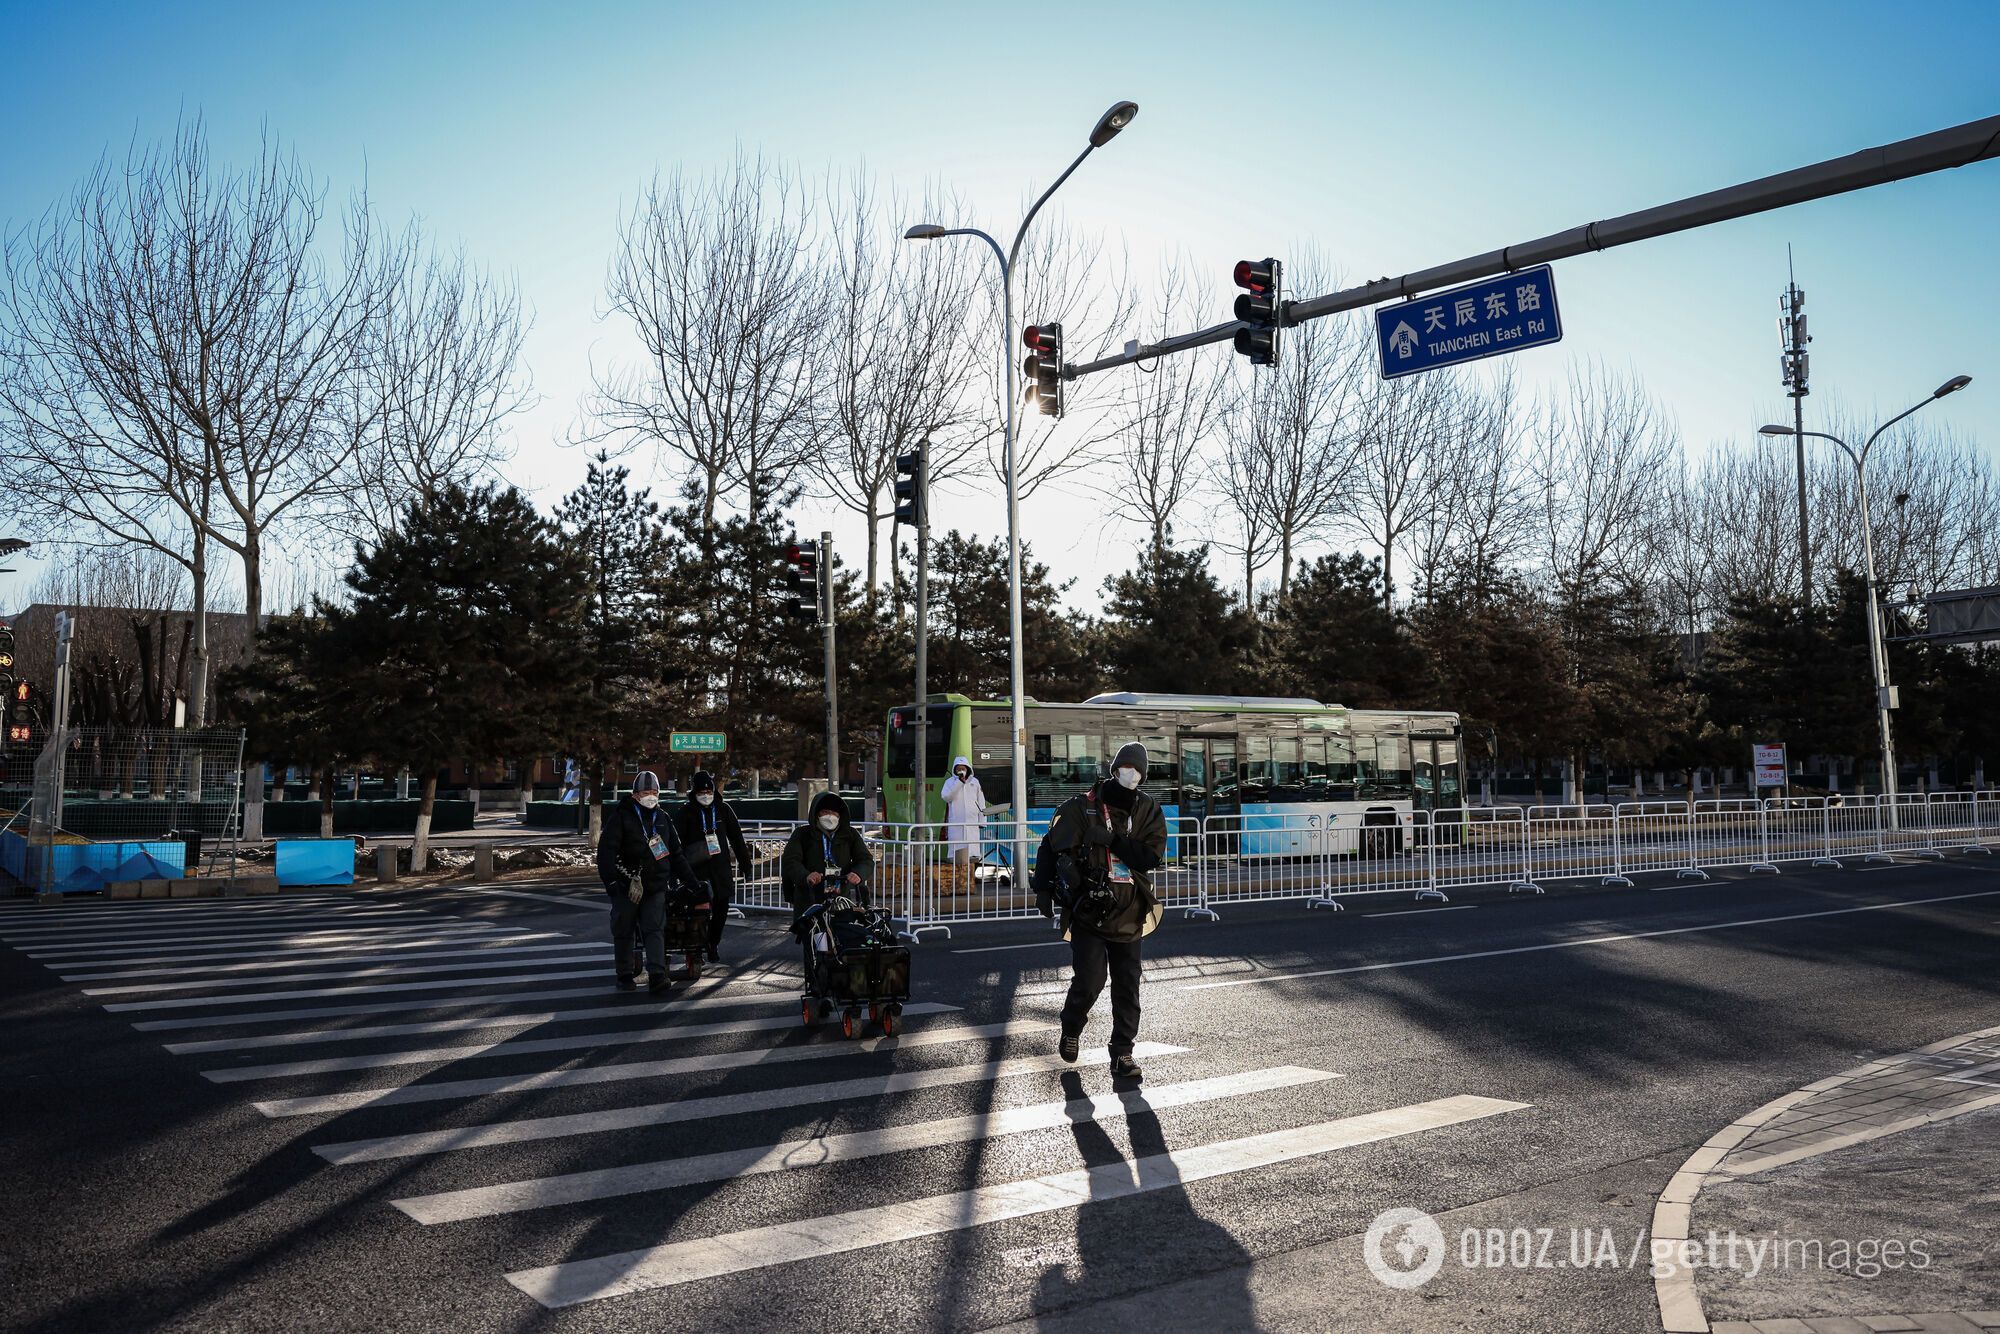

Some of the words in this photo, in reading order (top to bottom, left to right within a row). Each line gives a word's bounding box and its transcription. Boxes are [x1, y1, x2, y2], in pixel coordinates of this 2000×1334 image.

[1424, 283, 1541, 334] 天辰东路
[1398, 330, 1409, 345] 南
[1428, 331, 1490, 357] TIANCHEN
[1496, 325, 1523, 342] East
[1528, 318, 1546, 335] Rd
[1400, 345, 1409, 355] S
[11, 727, 30, 739] 等待
[682, 736, 715, 744] 天辰东路
